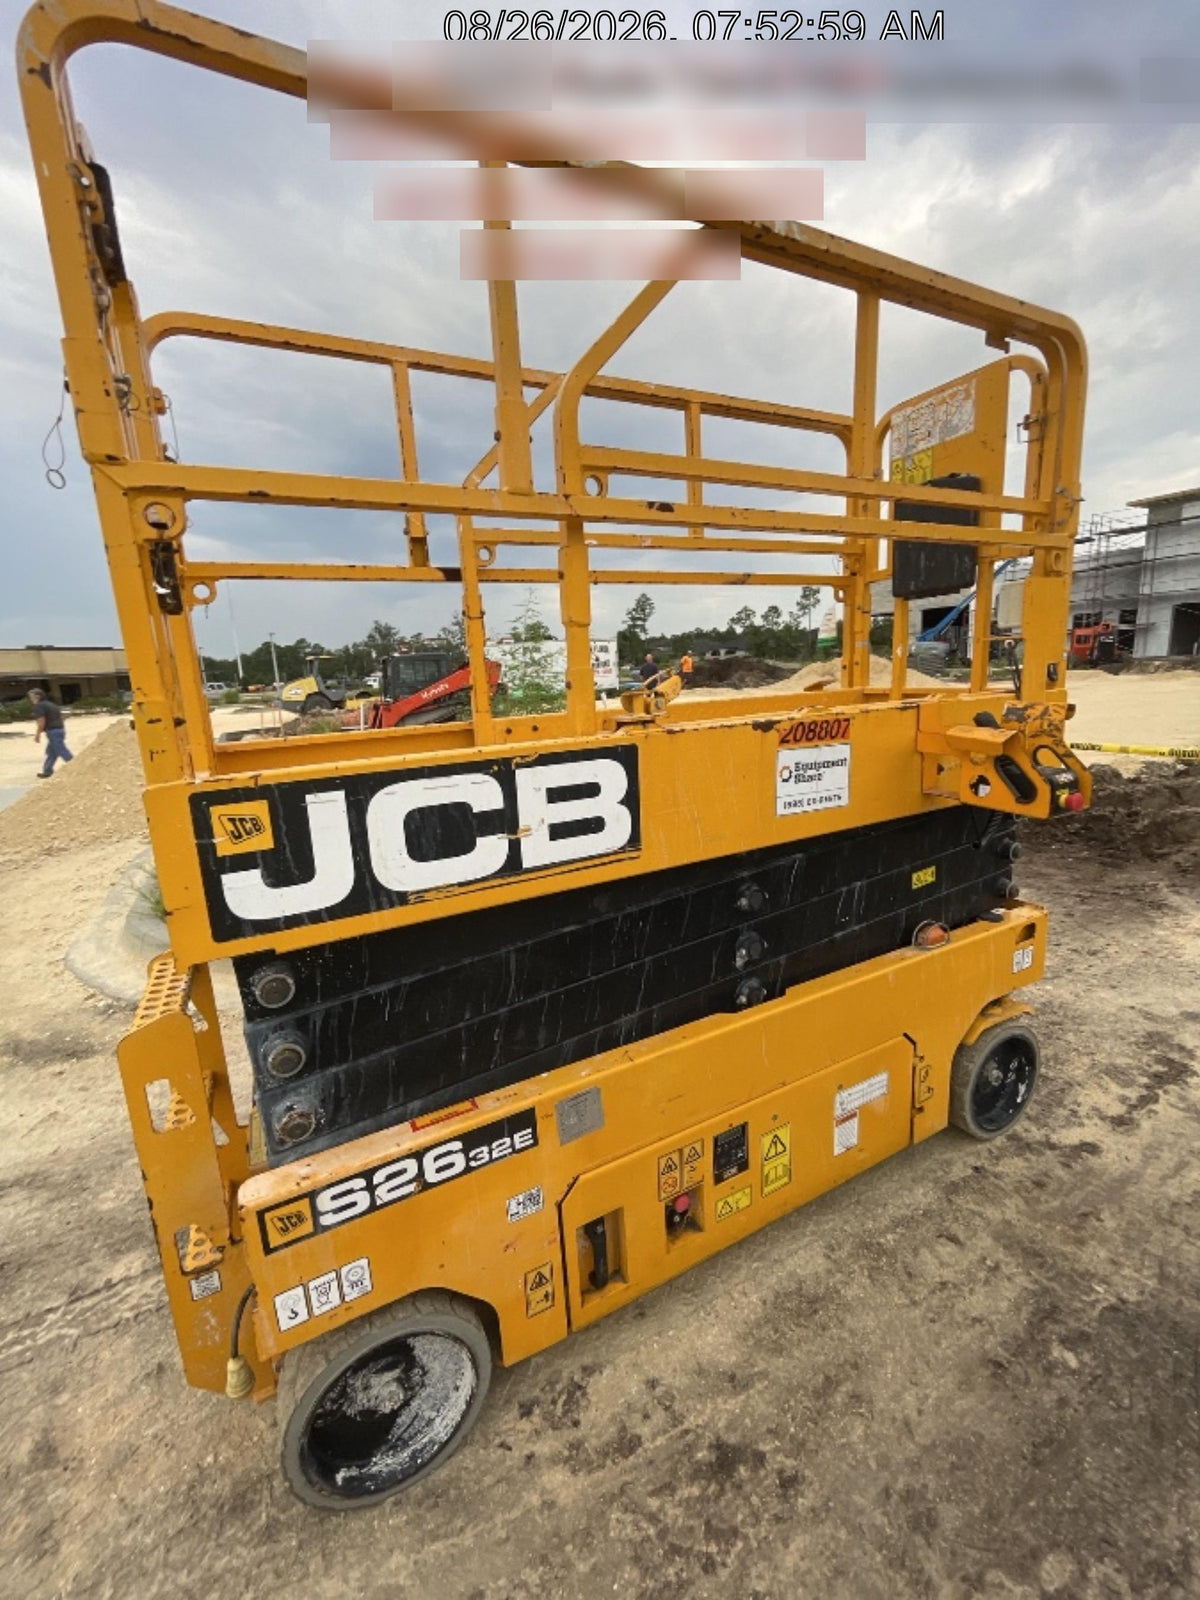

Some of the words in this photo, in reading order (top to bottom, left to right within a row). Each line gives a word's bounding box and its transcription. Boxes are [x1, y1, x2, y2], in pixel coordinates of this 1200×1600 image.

[779, 717, 850, 744] 208807
[221, 758, 632, 921] JCB
[226, 816, 262, 841] JCB
[275, 1212, 306, 1234] JCB
